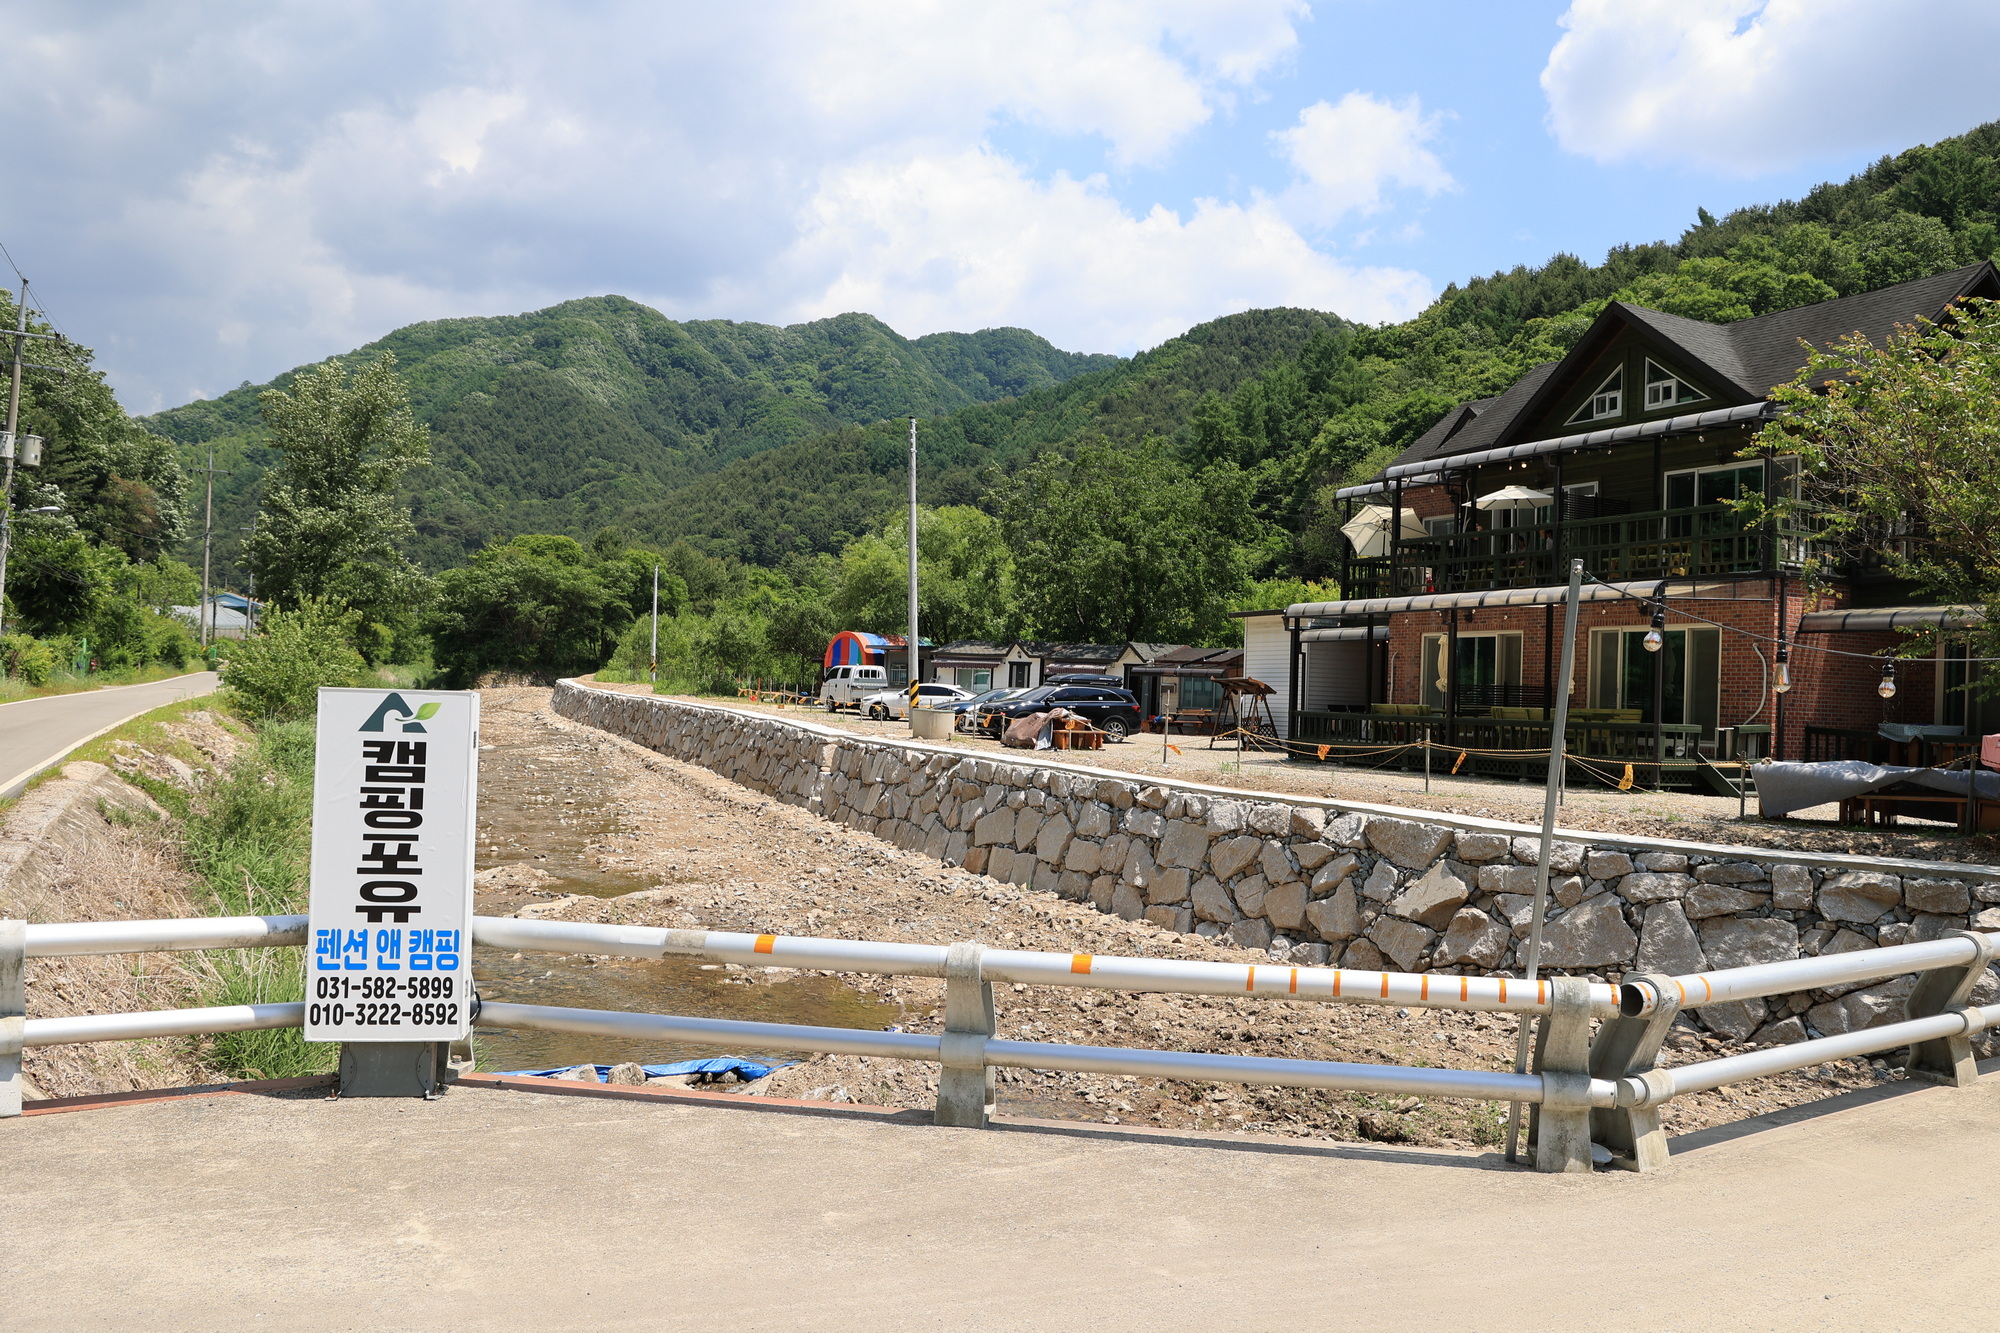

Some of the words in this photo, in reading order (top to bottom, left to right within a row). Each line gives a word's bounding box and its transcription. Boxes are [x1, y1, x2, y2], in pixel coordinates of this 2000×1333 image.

[356, 741, 426, 922] 캠핑포유
[316, 929, 368, 970] 펜션
[377, 929, 401, 970] 앤
[409, 930, 459, 970] 캠핑
[317, 977, 453, 999] 031-582-5899
[310, 1003, 457, 1025] 010-3222-8592
